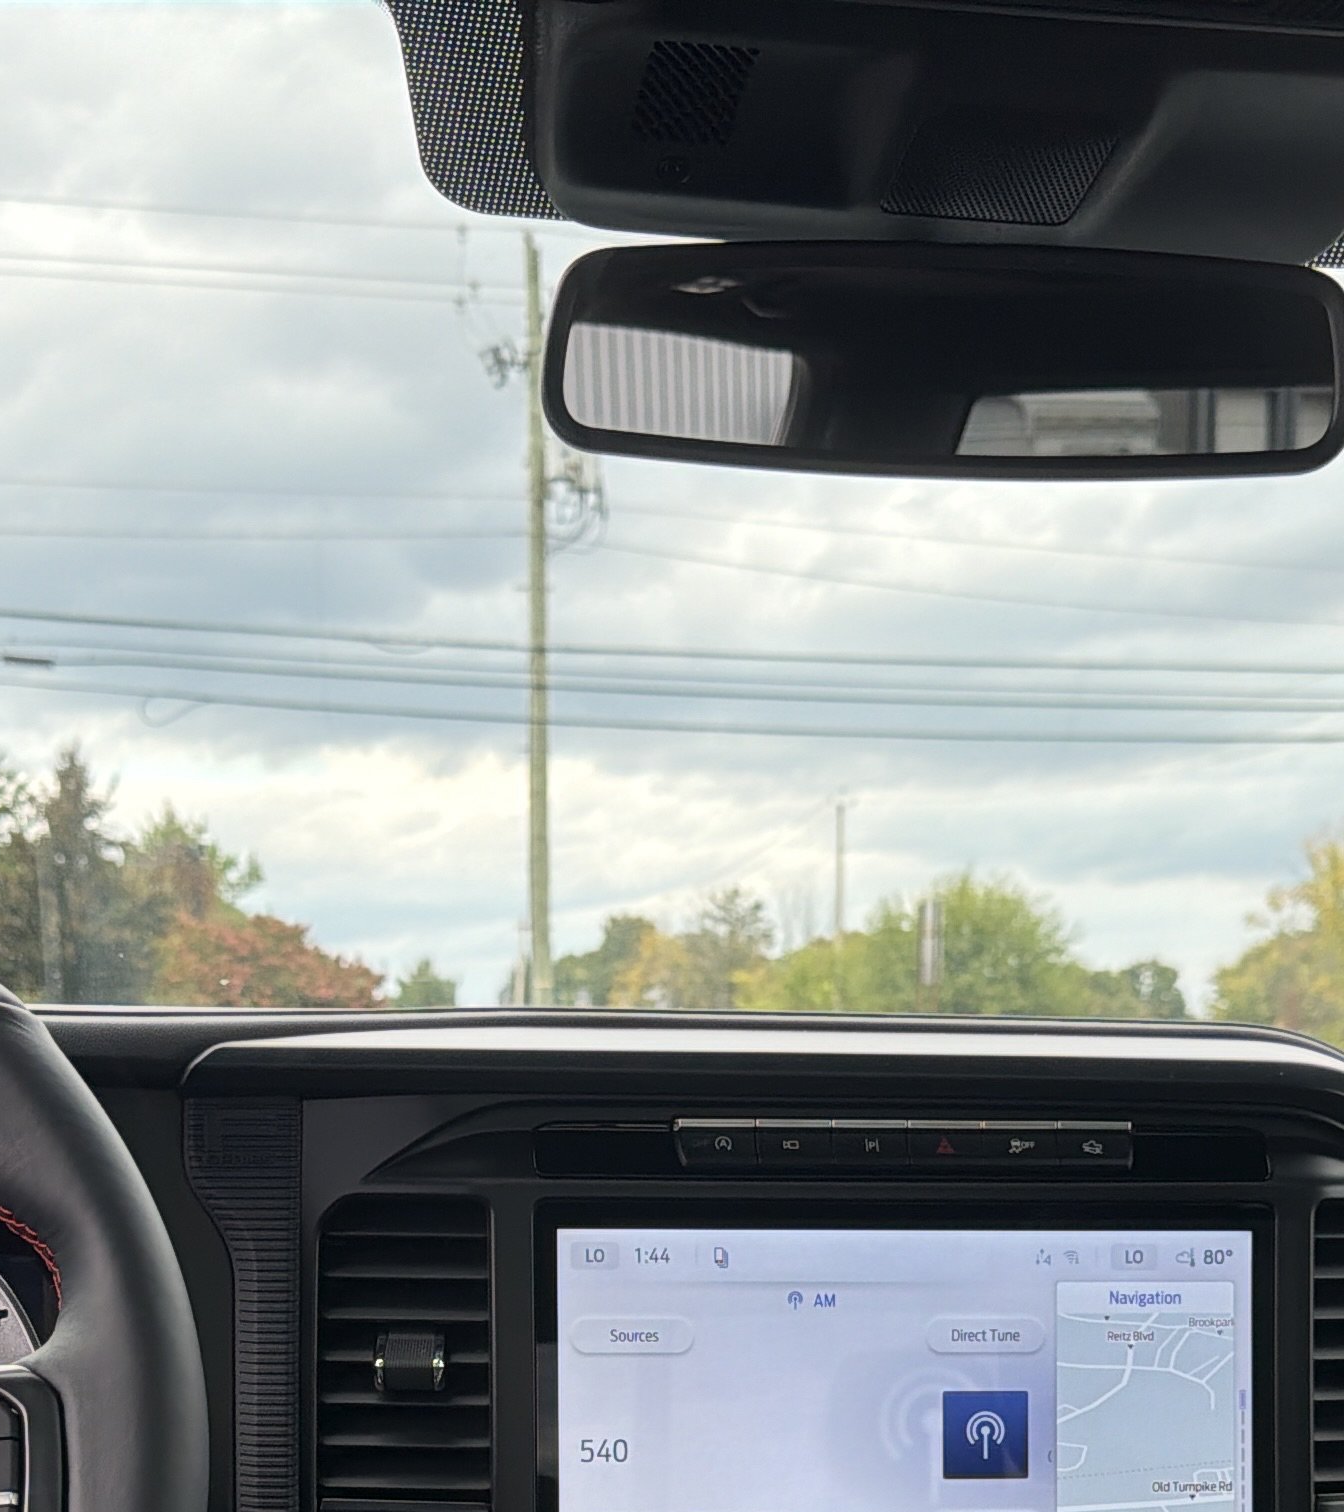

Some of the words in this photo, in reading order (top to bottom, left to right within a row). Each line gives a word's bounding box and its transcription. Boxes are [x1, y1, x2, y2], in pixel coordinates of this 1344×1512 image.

[1020, 1141, 1035, 1150] OFF
[585, 1249, 605, 1263] LO
[634, 1247, 671, 1264] 1:44
[1125, 1250, 1144, 1264] LO
[1203, 1249, 1233, 1265] 80°
[813, 1293, 836, 1308] AM
[1109, 1291, 1182, 1308] Navigation
[609, 1328, 659, 1343] Sources
[951, 1328, 987, 1342] Direct
[989, 1328, 1021, 1342] Tune
[1107, 1331, 1131, 1342] Reitz
[1133, 1331, 1154, 1342] Blvd
[580, 1438, 628, 1463] 540
[1152, 1481, 1170, 1492] Old
[1173, 1481, 1217, 1494] Turnpike
[1219, 1481, 1233, 1492] Rd
